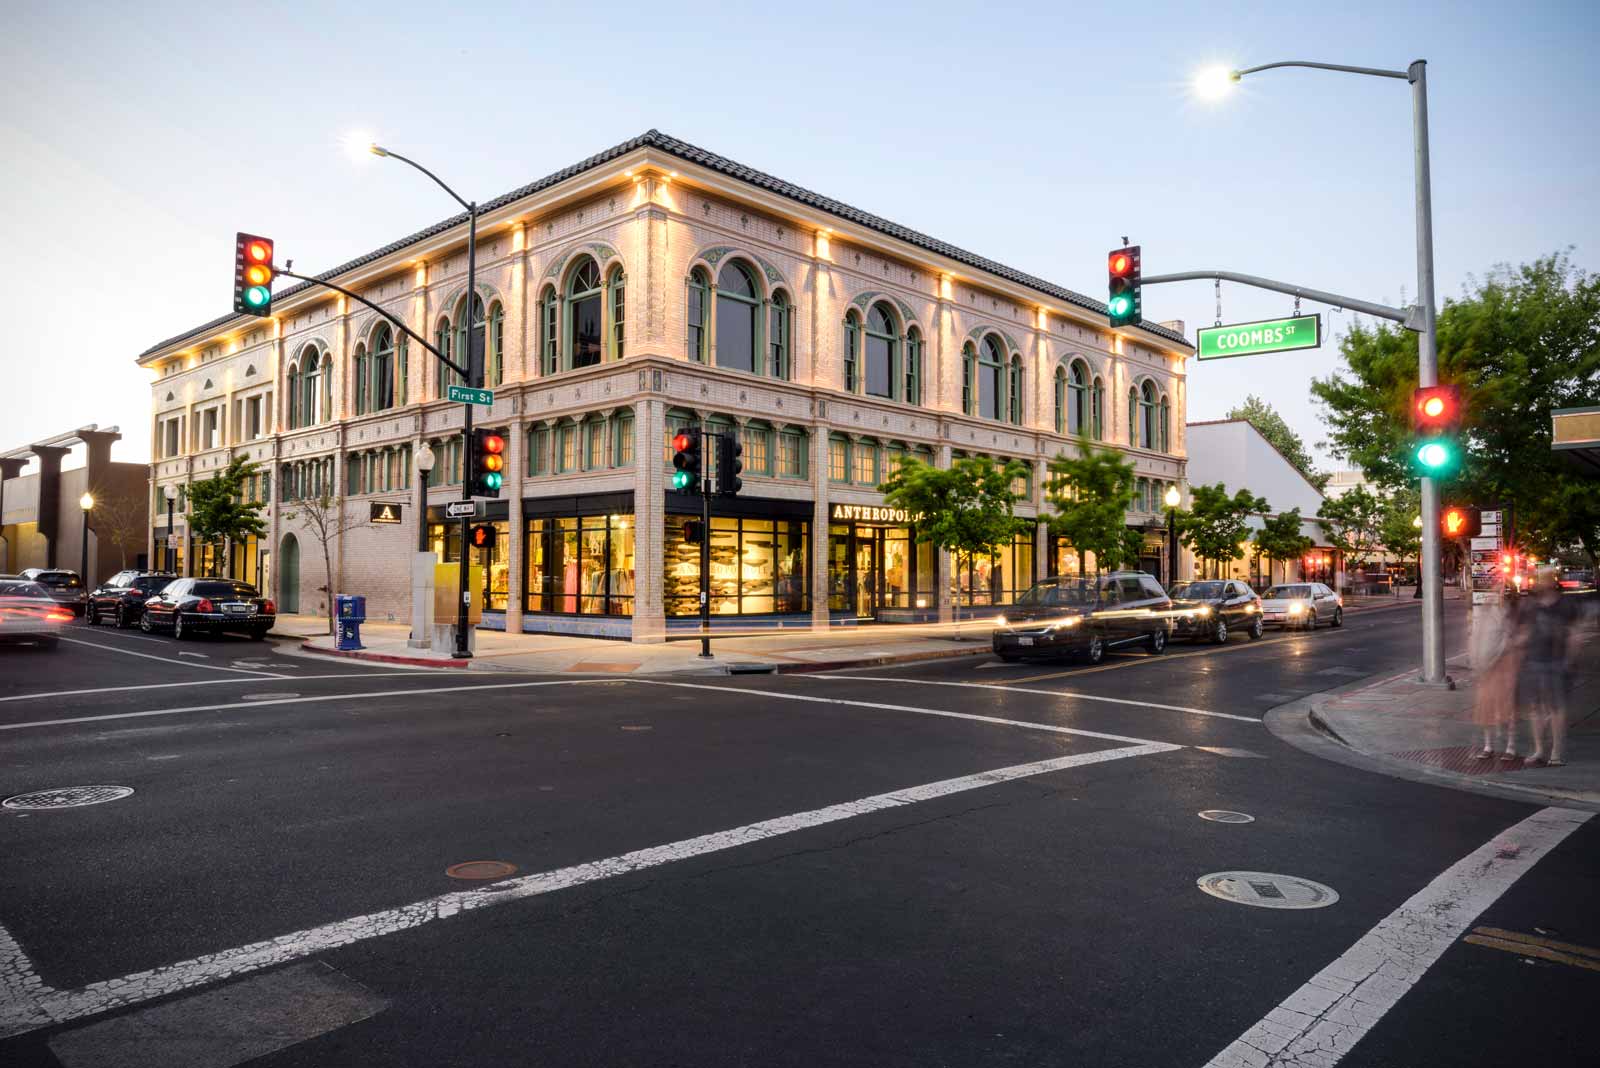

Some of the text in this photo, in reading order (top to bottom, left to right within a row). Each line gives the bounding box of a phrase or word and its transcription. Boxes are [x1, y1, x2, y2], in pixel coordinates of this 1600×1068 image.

[1216, 325, 1296, 350] COOMBS ST
[451, 388, 491, 404] First St
[379, 505, 395, 519] A
[833, 504, 937, 523] ANTHROPOLO
